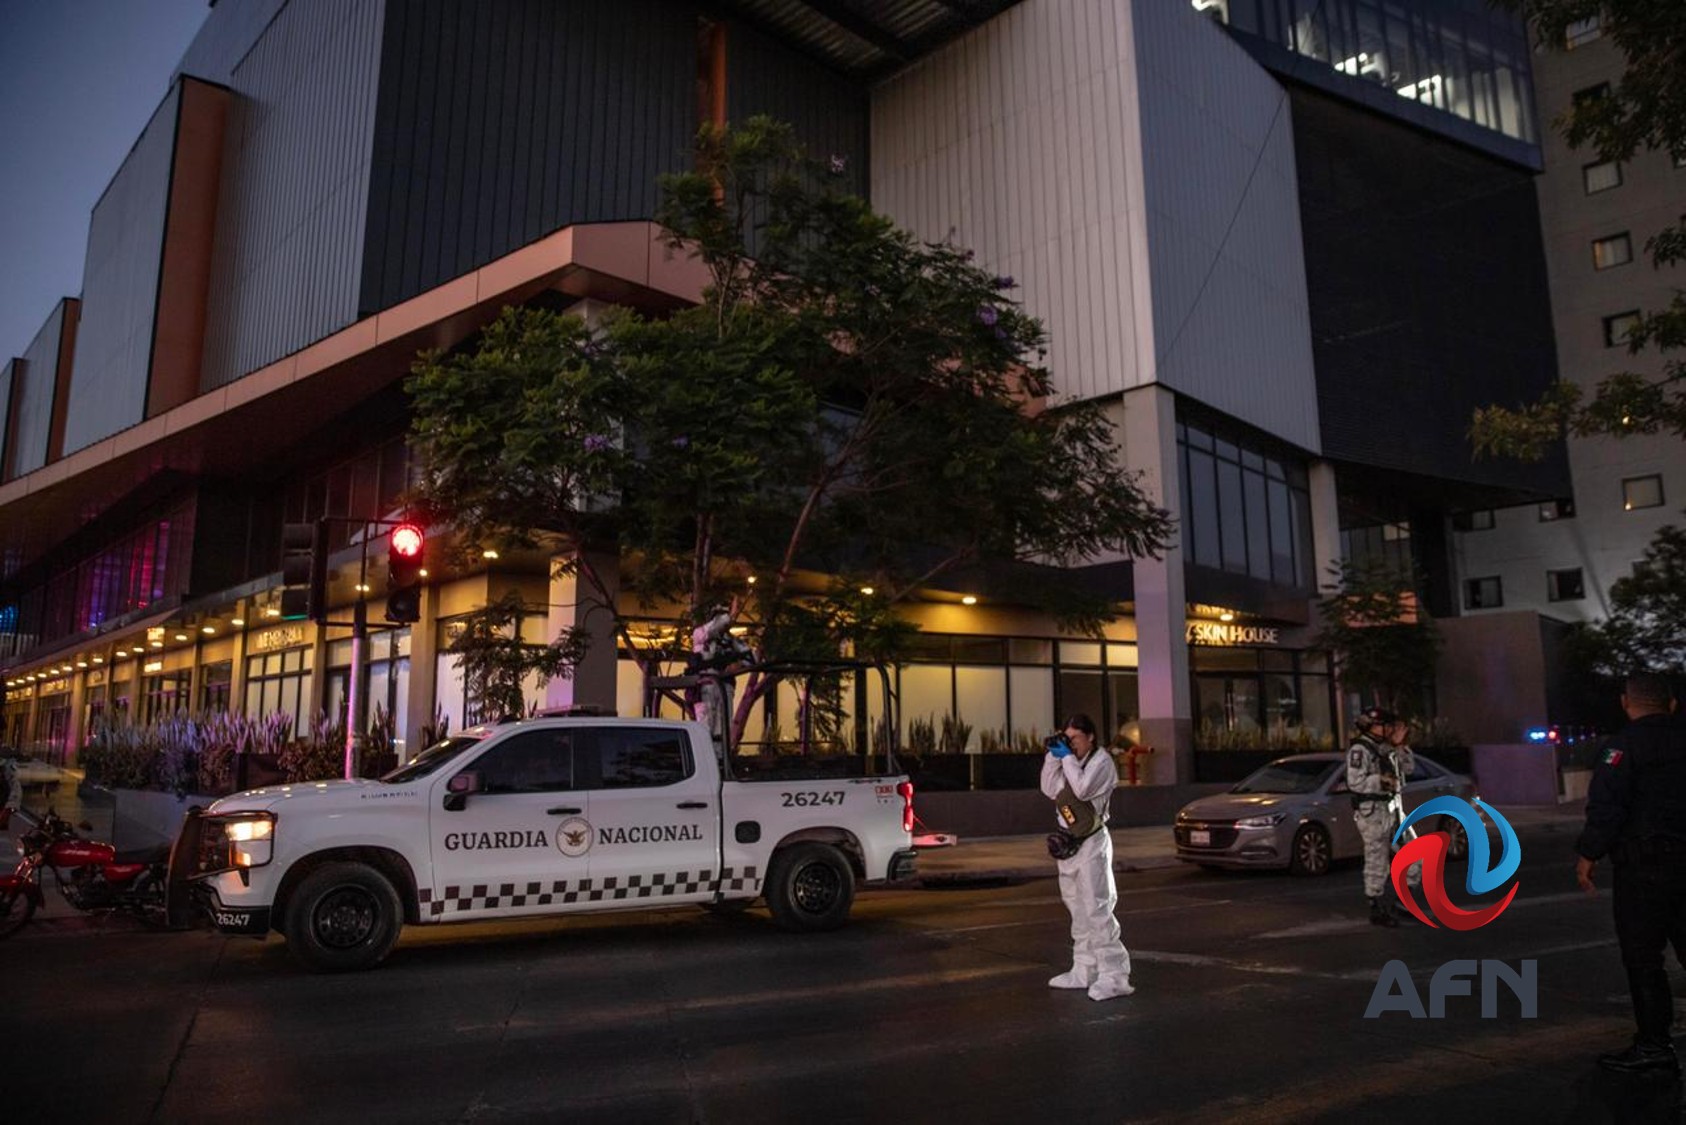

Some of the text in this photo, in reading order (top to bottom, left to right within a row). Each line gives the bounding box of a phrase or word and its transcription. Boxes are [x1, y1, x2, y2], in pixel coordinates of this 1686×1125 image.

[1196, 622, 1278, 643] SKIN HOUSE
[781, 791, 845, 807] 26247
[444, 830, 549, 851] GUARDIA
[599, 824, 703, 845] NACIONAL
[216, 912, 251, 926] 26247
